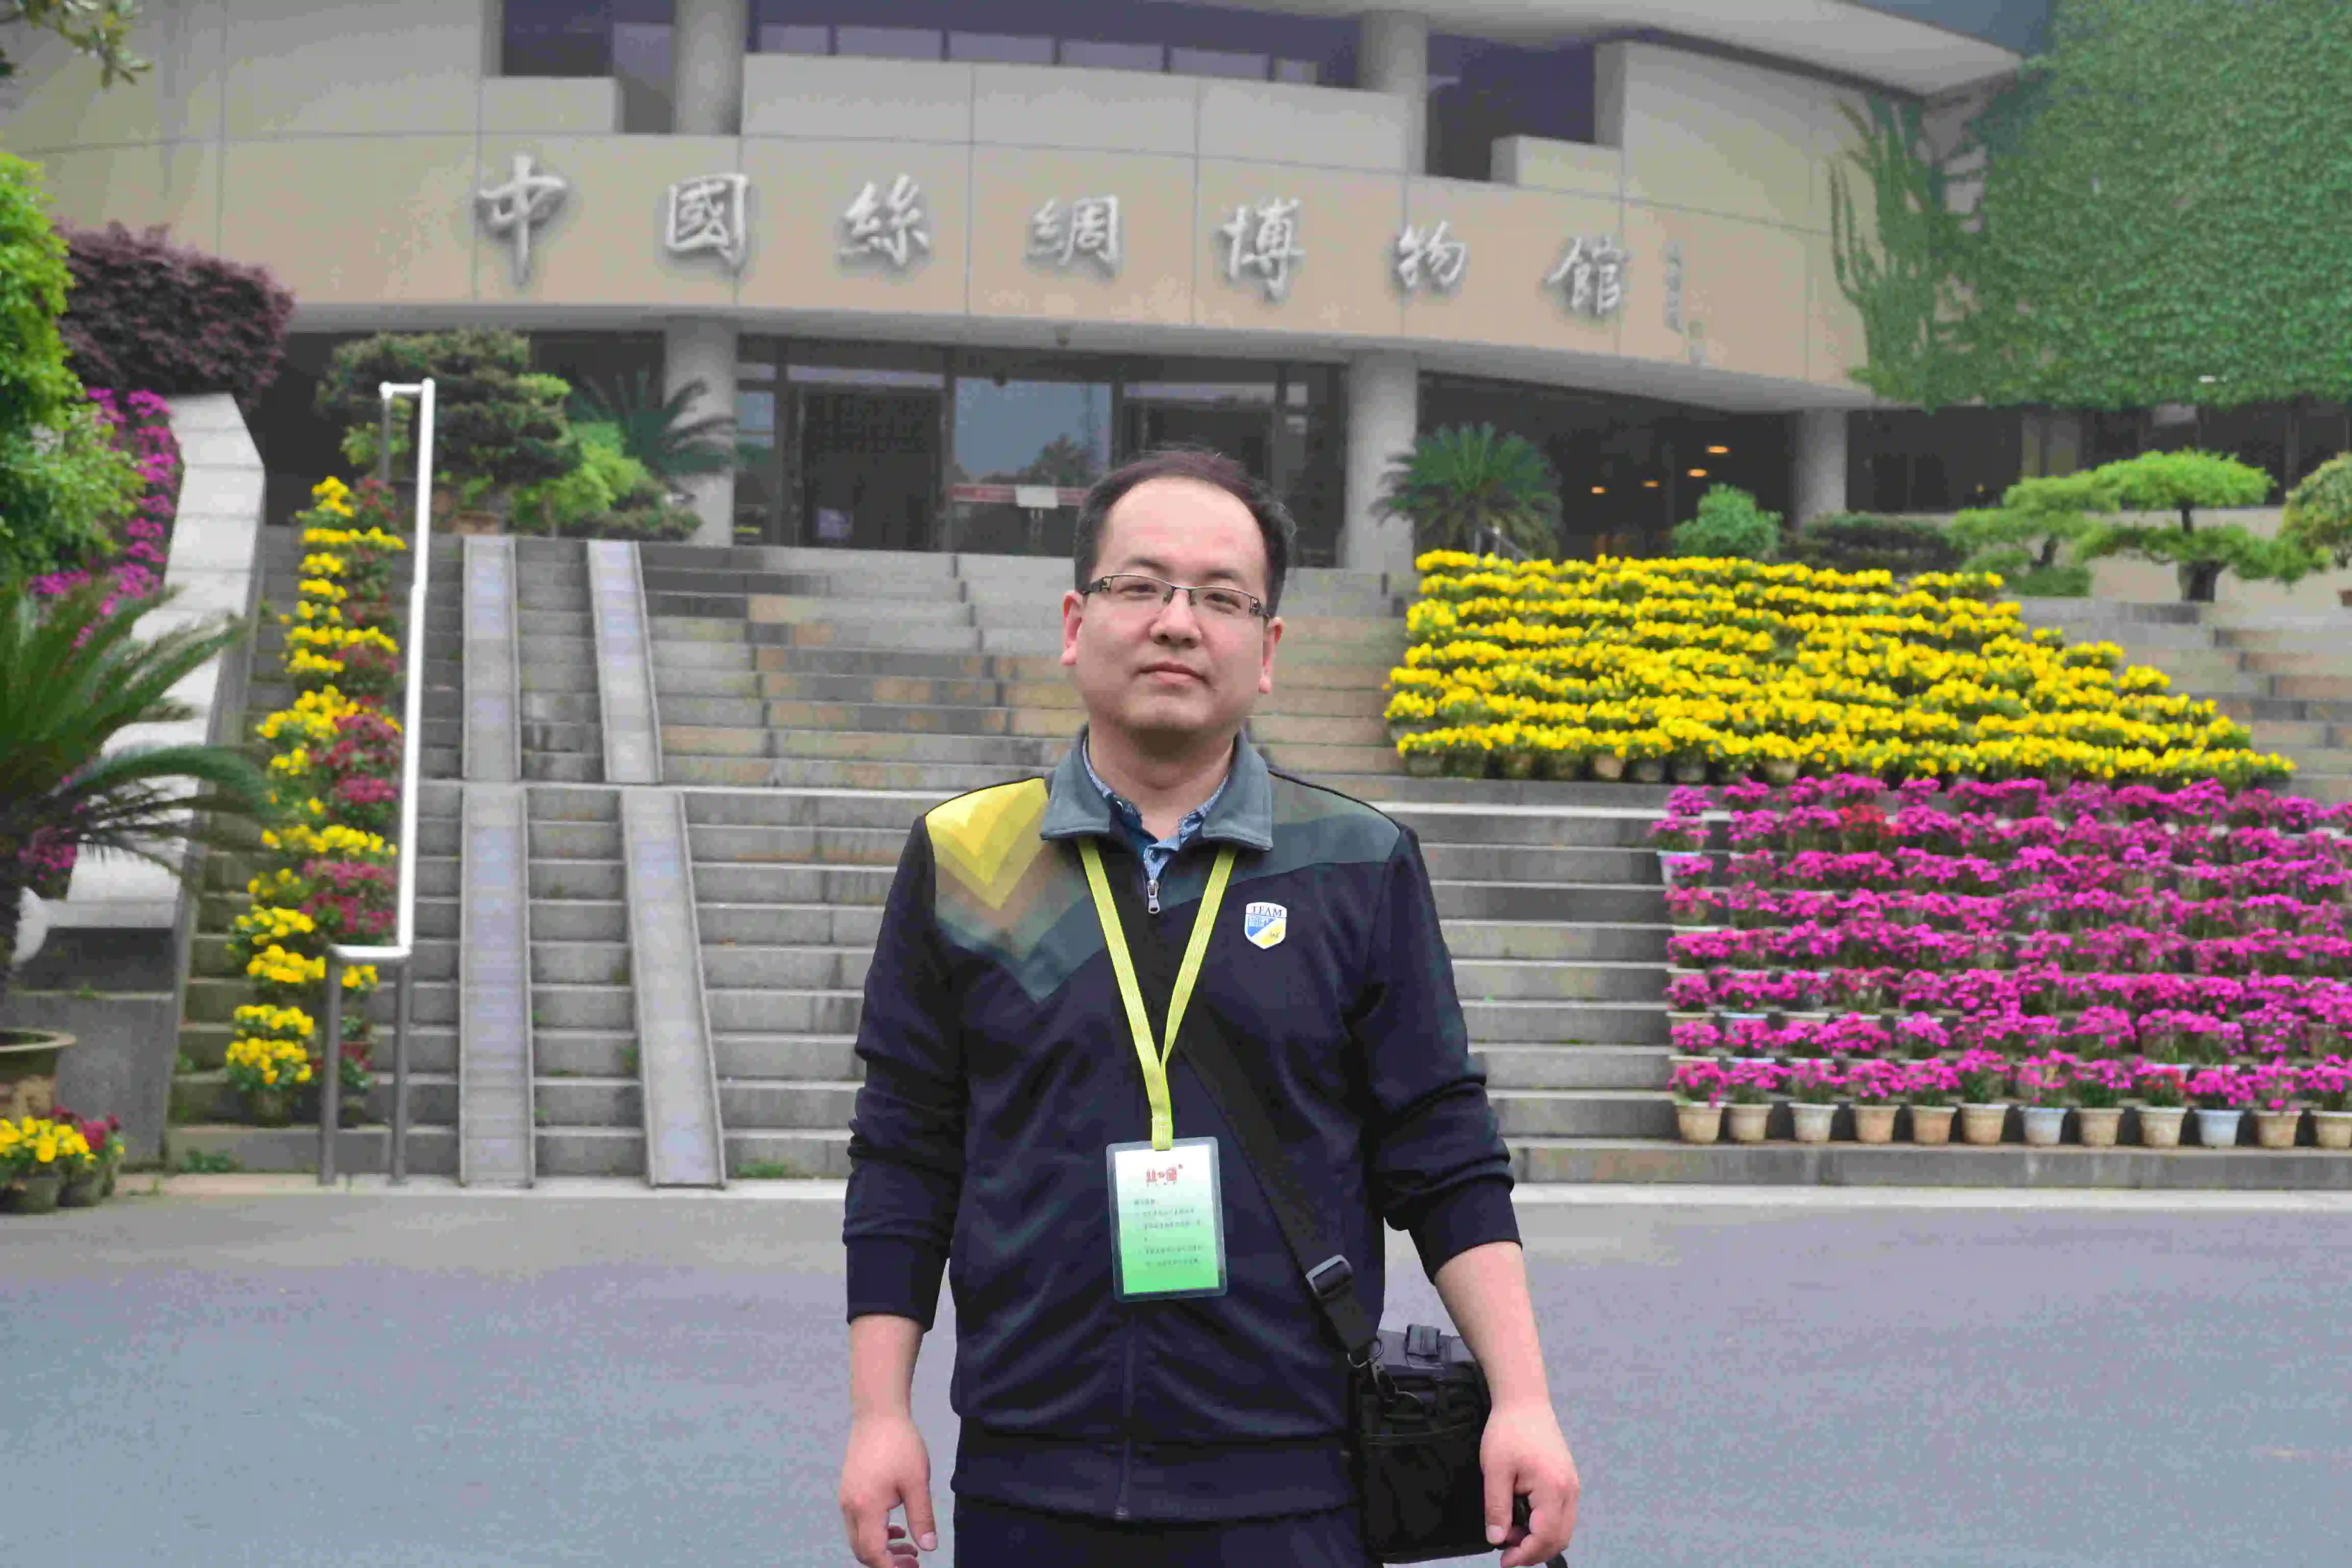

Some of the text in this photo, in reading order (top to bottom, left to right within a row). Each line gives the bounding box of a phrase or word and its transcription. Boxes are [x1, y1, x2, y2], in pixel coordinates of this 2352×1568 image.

[476, 152, 1628, 312] 中國絲綢博物館
[1251, 905, 1282, 917] TEAM
